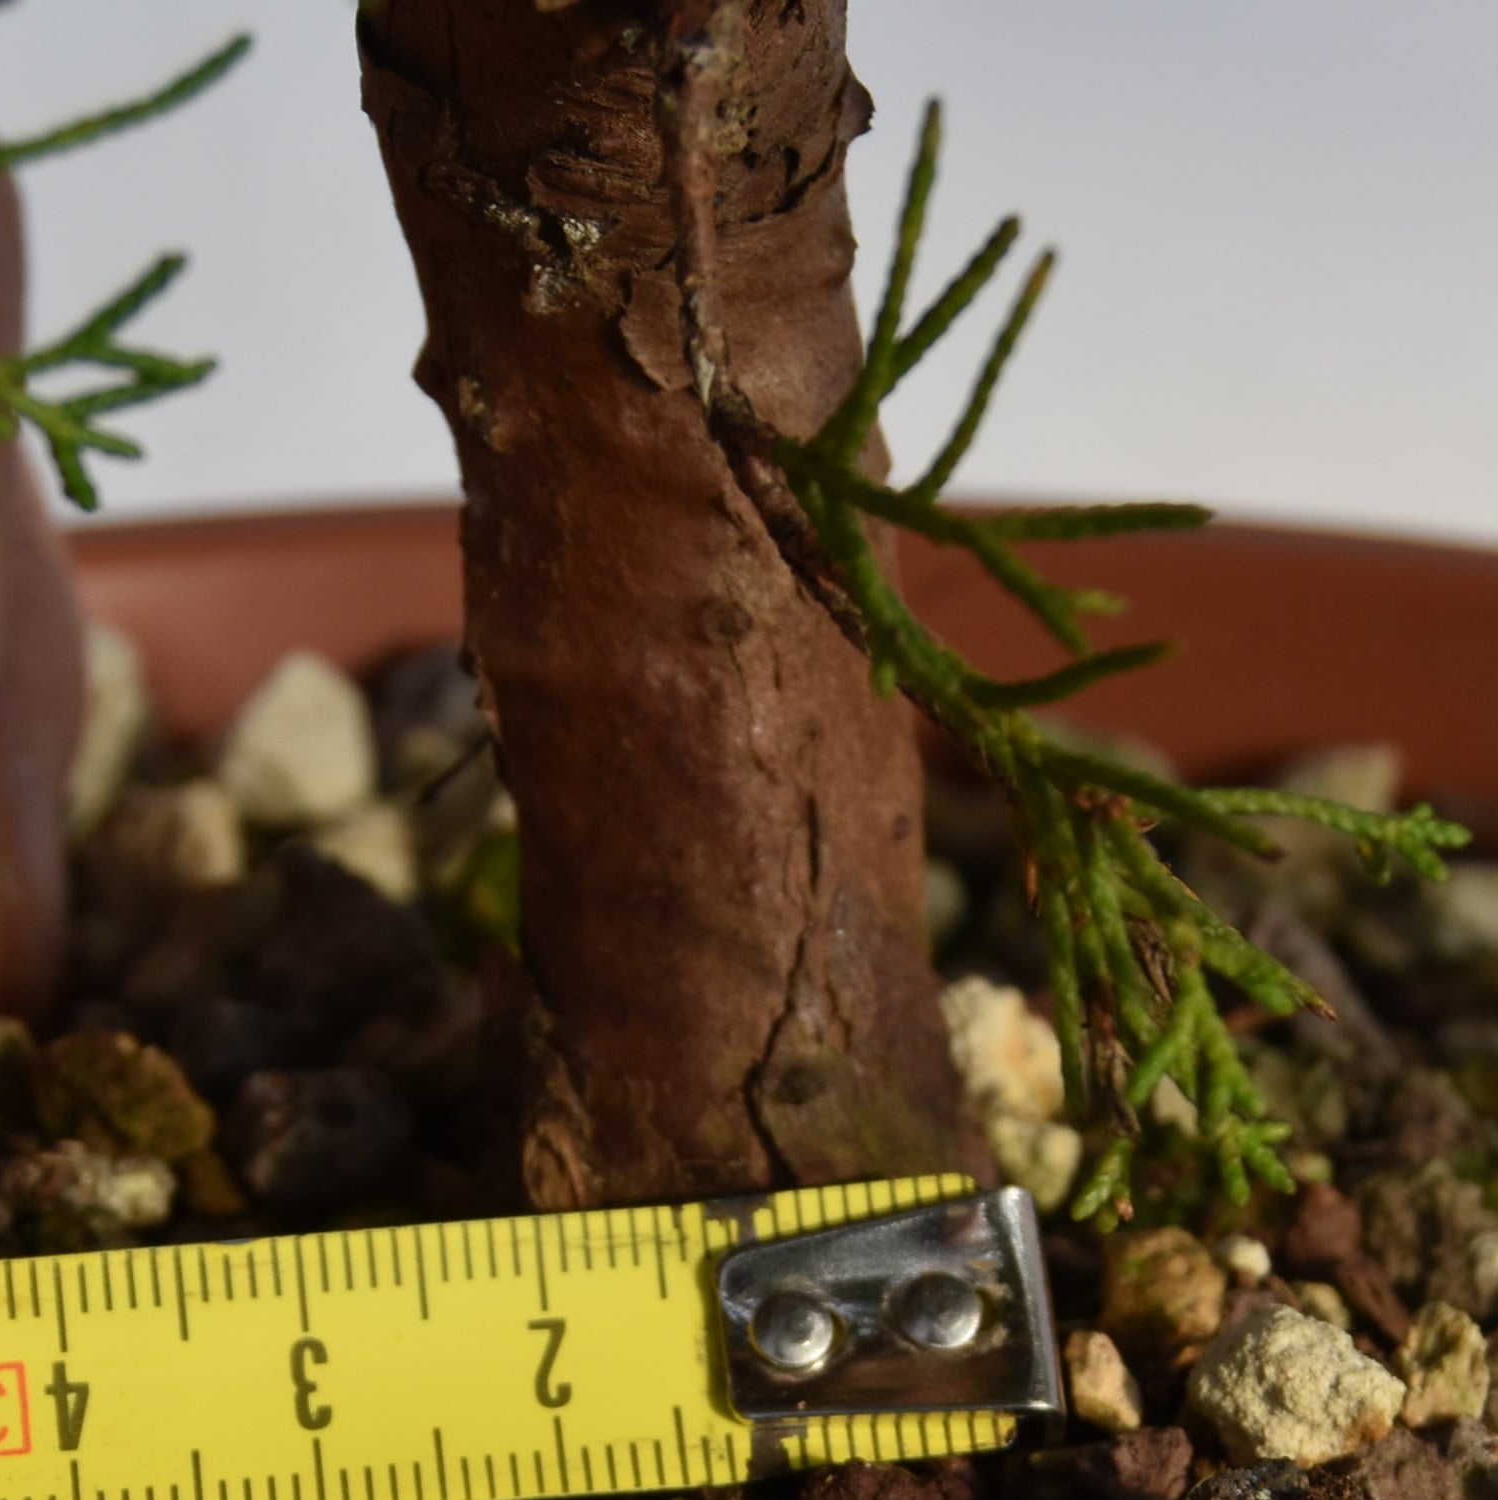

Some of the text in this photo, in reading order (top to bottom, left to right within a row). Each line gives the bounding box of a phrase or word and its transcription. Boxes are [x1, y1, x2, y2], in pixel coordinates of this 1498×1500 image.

[44, 1360, 90, 1451] 4
[289, 1336, 332, 1431] 3
[527, 1317, 573, 1408] 2
